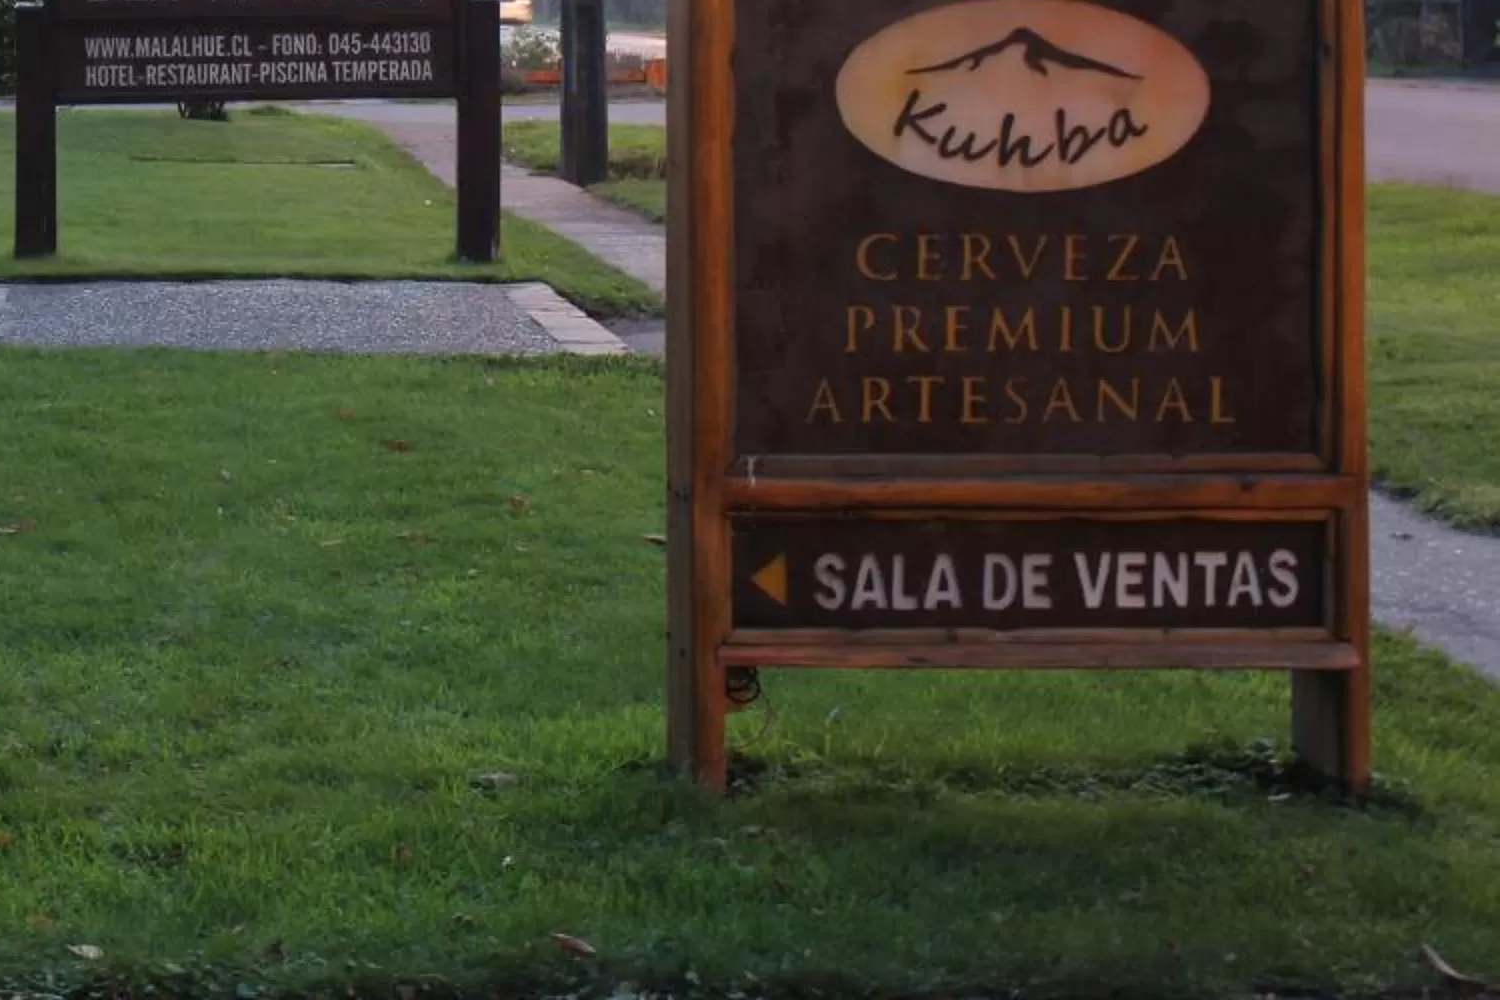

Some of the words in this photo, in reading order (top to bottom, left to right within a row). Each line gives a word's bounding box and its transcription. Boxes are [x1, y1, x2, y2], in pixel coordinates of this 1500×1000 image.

[84, 34, 253, 59] WWW.MALALHUE.CL
[271, 33, 323, 56] FONO:
[328, 31, 432, 55] 045-443130
[332, 59, 433, 82] TEMPERADA
[892, 89, 1148, 168] Kuhba
[855, 232, 1190, 283] CERVEZA
[843, 305, 1201, 353] PREMIUM
[804, 375, 1236, 425] ARTESANAL
[812, 552, 962, 611] SALA
[982, 552, 1053, 610] DE
[1073, 547, 1300, 610] VENTAS
